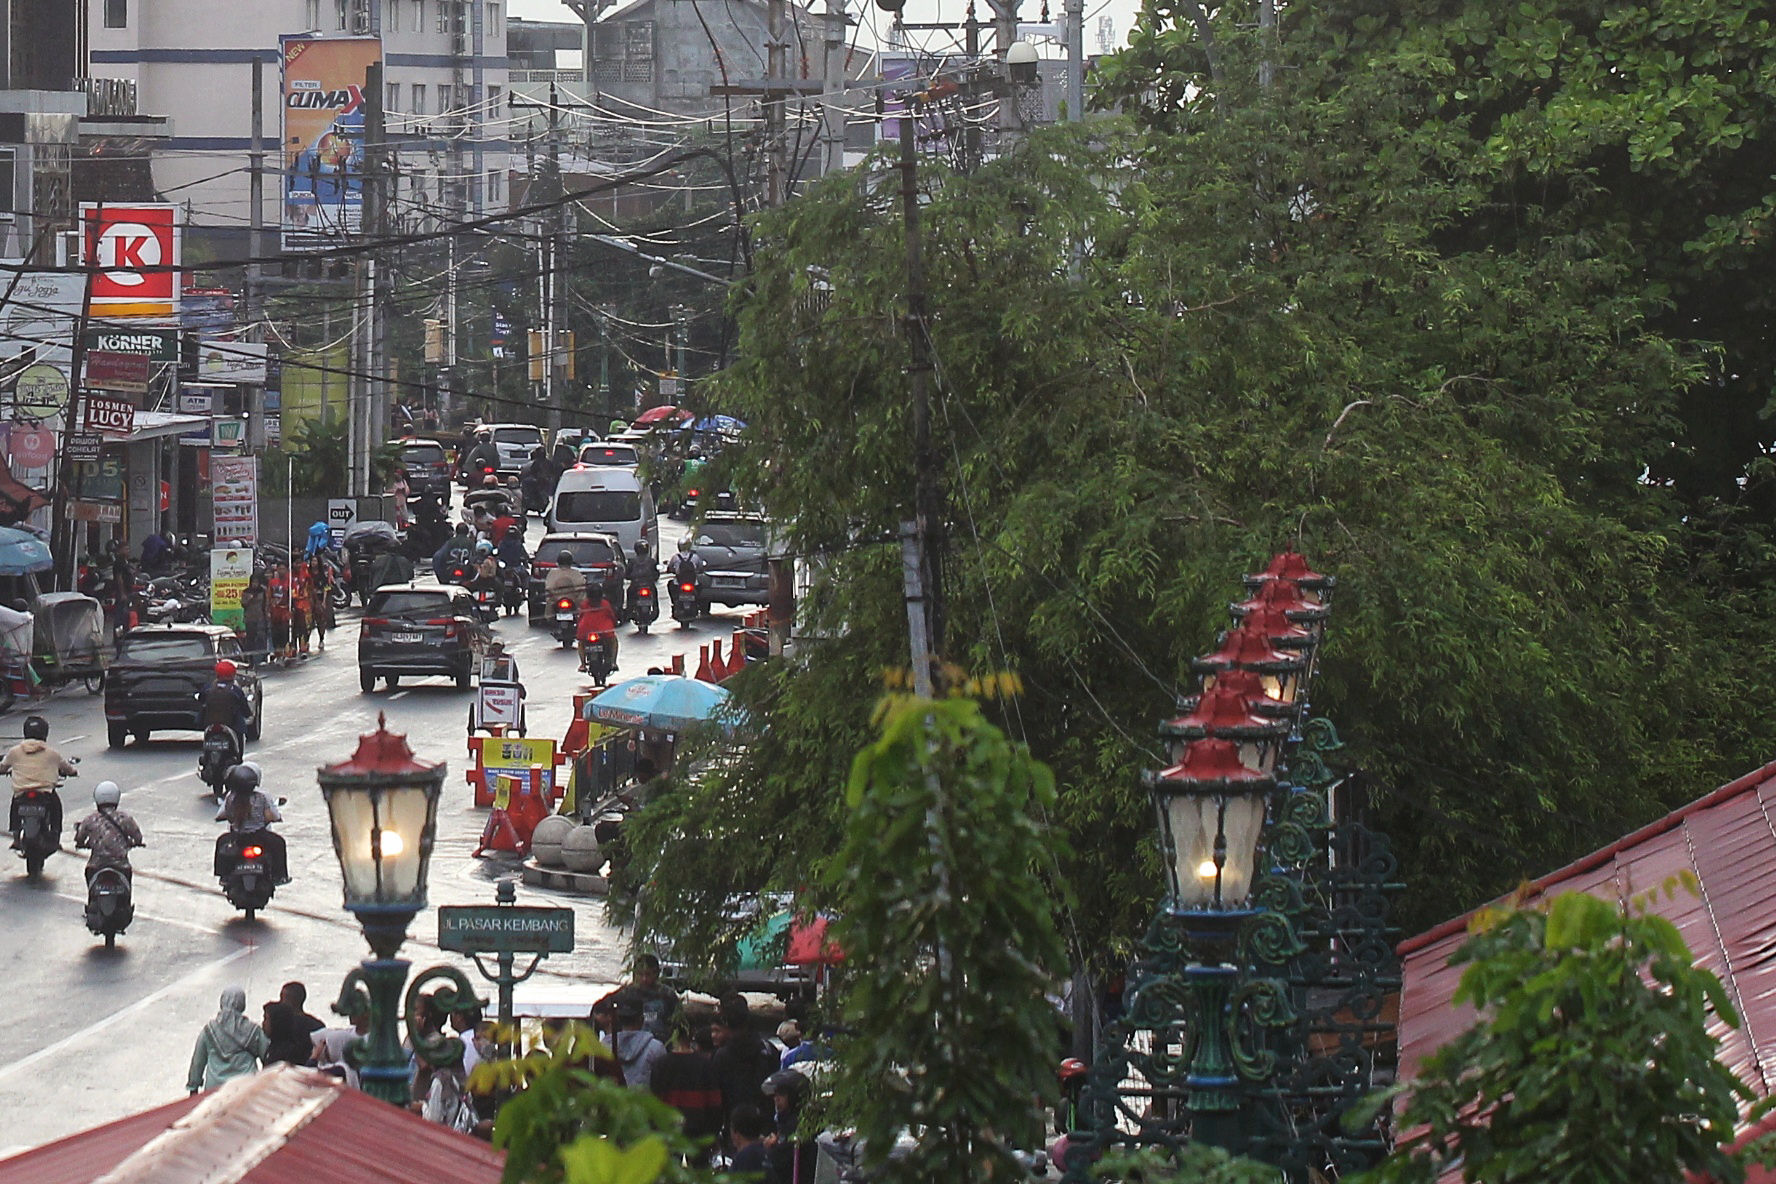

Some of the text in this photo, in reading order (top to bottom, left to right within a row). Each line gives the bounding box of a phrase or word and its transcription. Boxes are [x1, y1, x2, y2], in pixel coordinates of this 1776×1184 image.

[285, 42, 306, 63] NEW
[98, 335, 163, 351] KÖRNER
[90, 399, 134, 413] LOSMEN
[88, 409, 132, 427] LUCY
[332, 510, 351, 518] OUT
[459, 918, 502, 931] PASAR
[504, 918, 569, 932] KEMBANG
